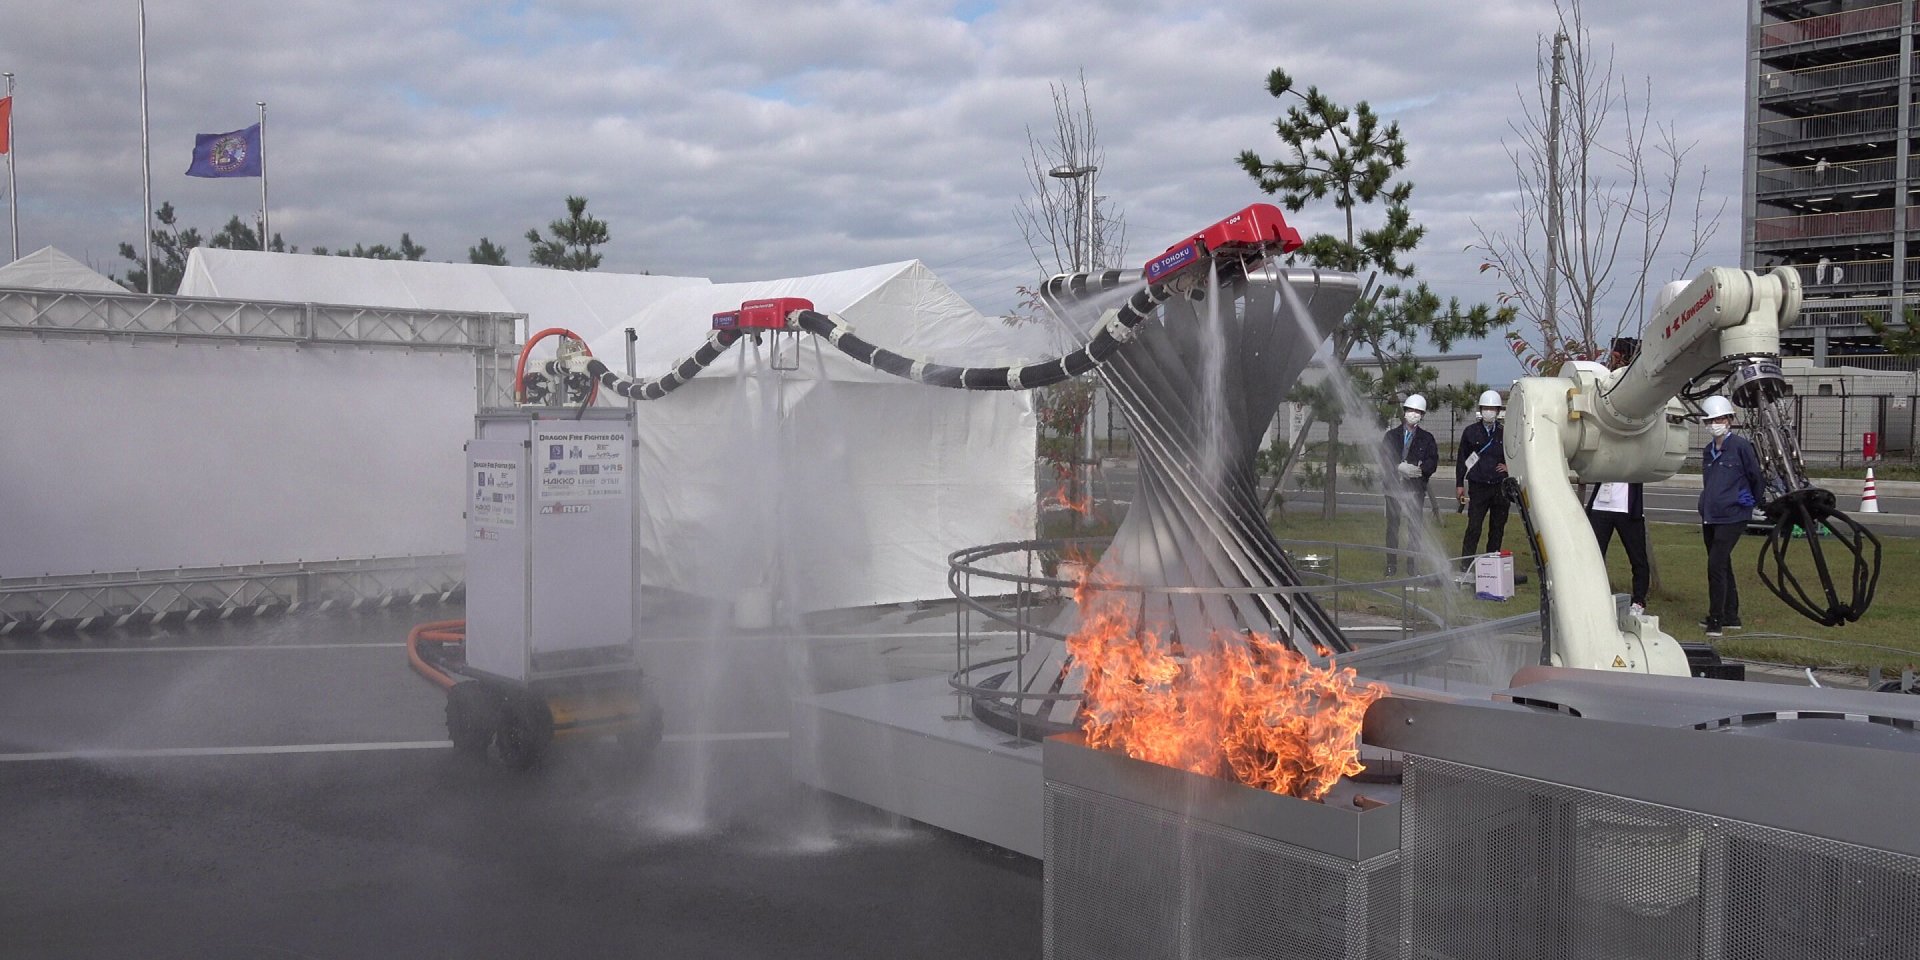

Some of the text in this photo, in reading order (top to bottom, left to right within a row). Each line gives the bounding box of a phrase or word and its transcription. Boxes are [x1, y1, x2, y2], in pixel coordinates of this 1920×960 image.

[1161, 247, 1189, 267] TOHOKU
[1681, 285, 1714, 325] Kawasaki
[543, 477, 575, 485] HAKKO
